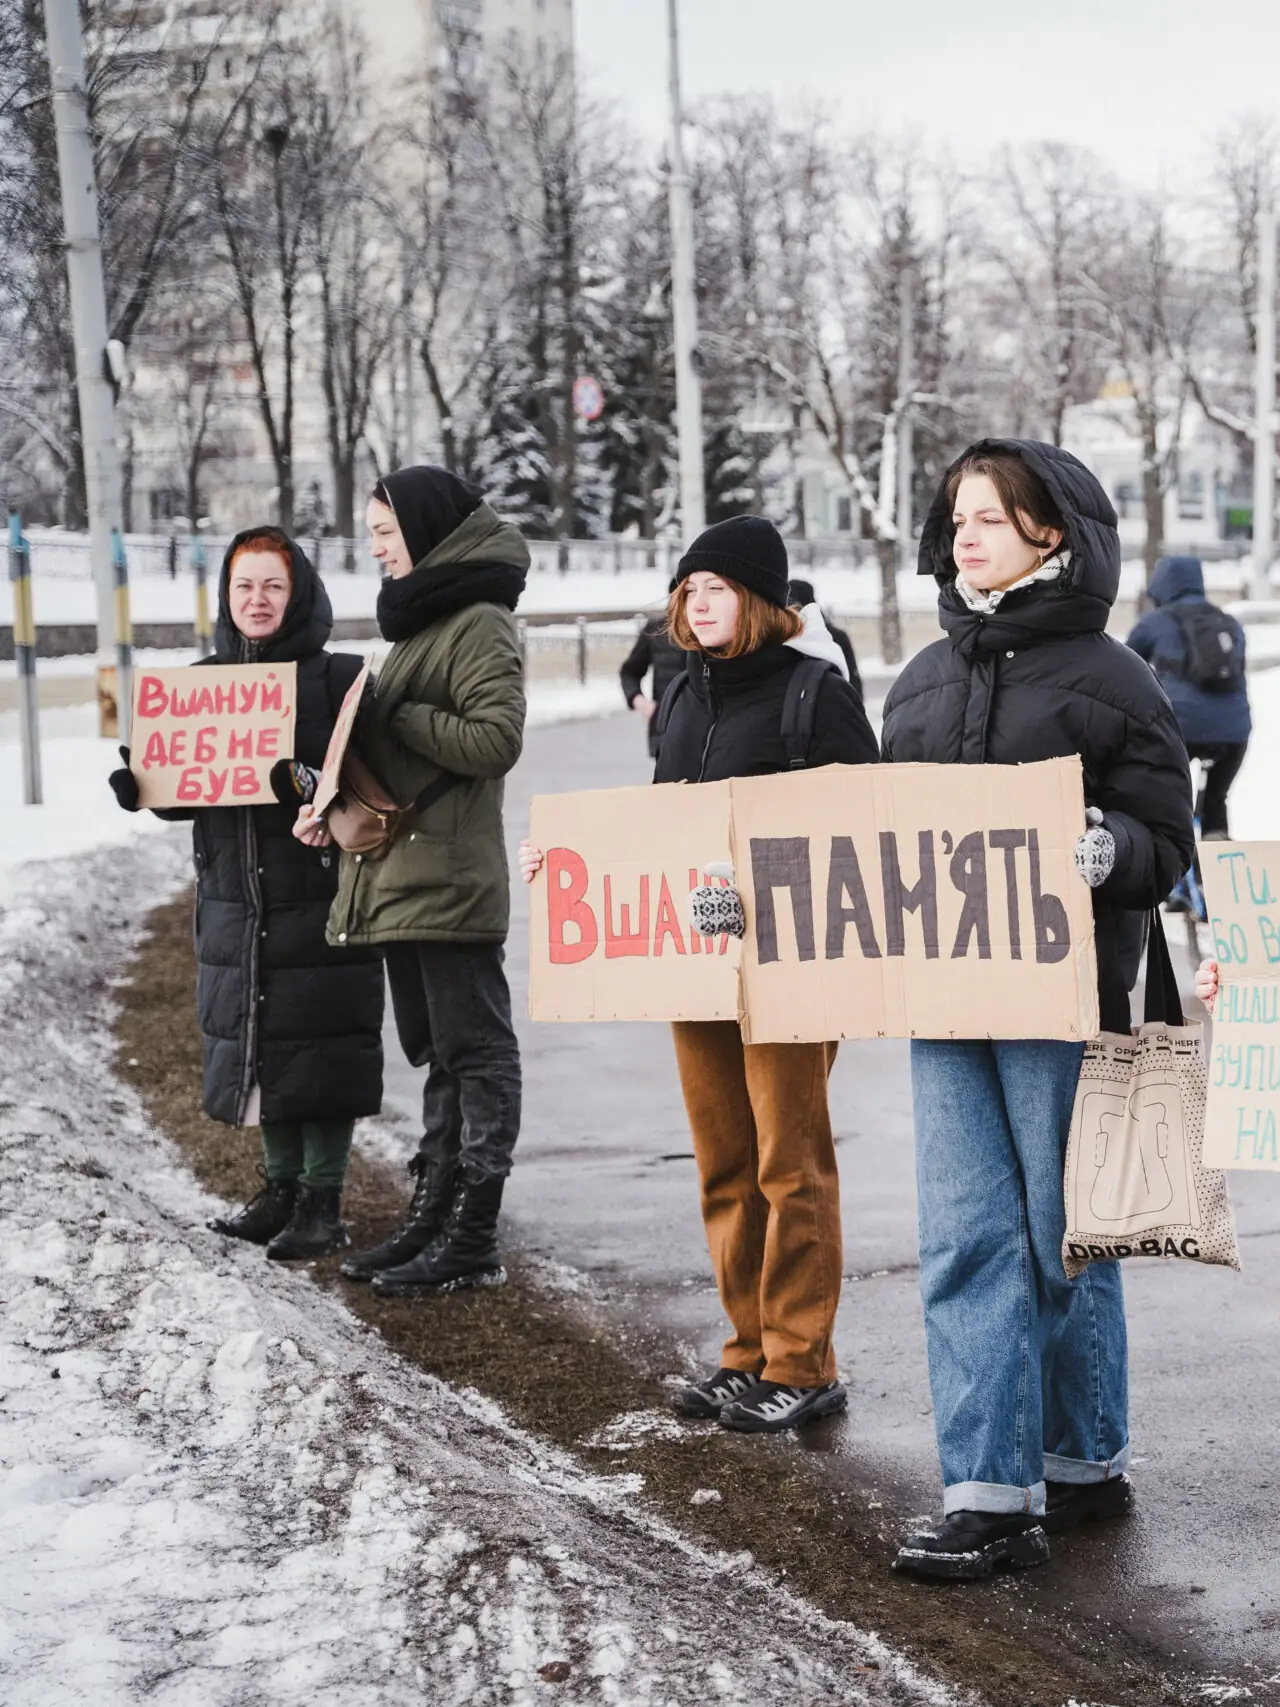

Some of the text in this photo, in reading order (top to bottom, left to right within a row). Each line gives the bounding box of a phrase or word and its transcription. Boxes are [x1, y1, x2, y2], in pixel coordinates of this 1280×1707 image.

[227, 727, 281, 759] НЕ
[176, 766, 260, 804] БУВ
[749, 828, 1070, 965] ПАМ'ЯТЬ
[1217, 852, 1276, 905] Ти
[1085, 1044, 1107, 1052] ERE
[1114, 1047, 1137, 1056] OPE
[1174, 1039, 1200, 1047] HERE
[1234, 1107, 1278, 1162] НА
[1139, 1237, 1200, 1257] BAG
